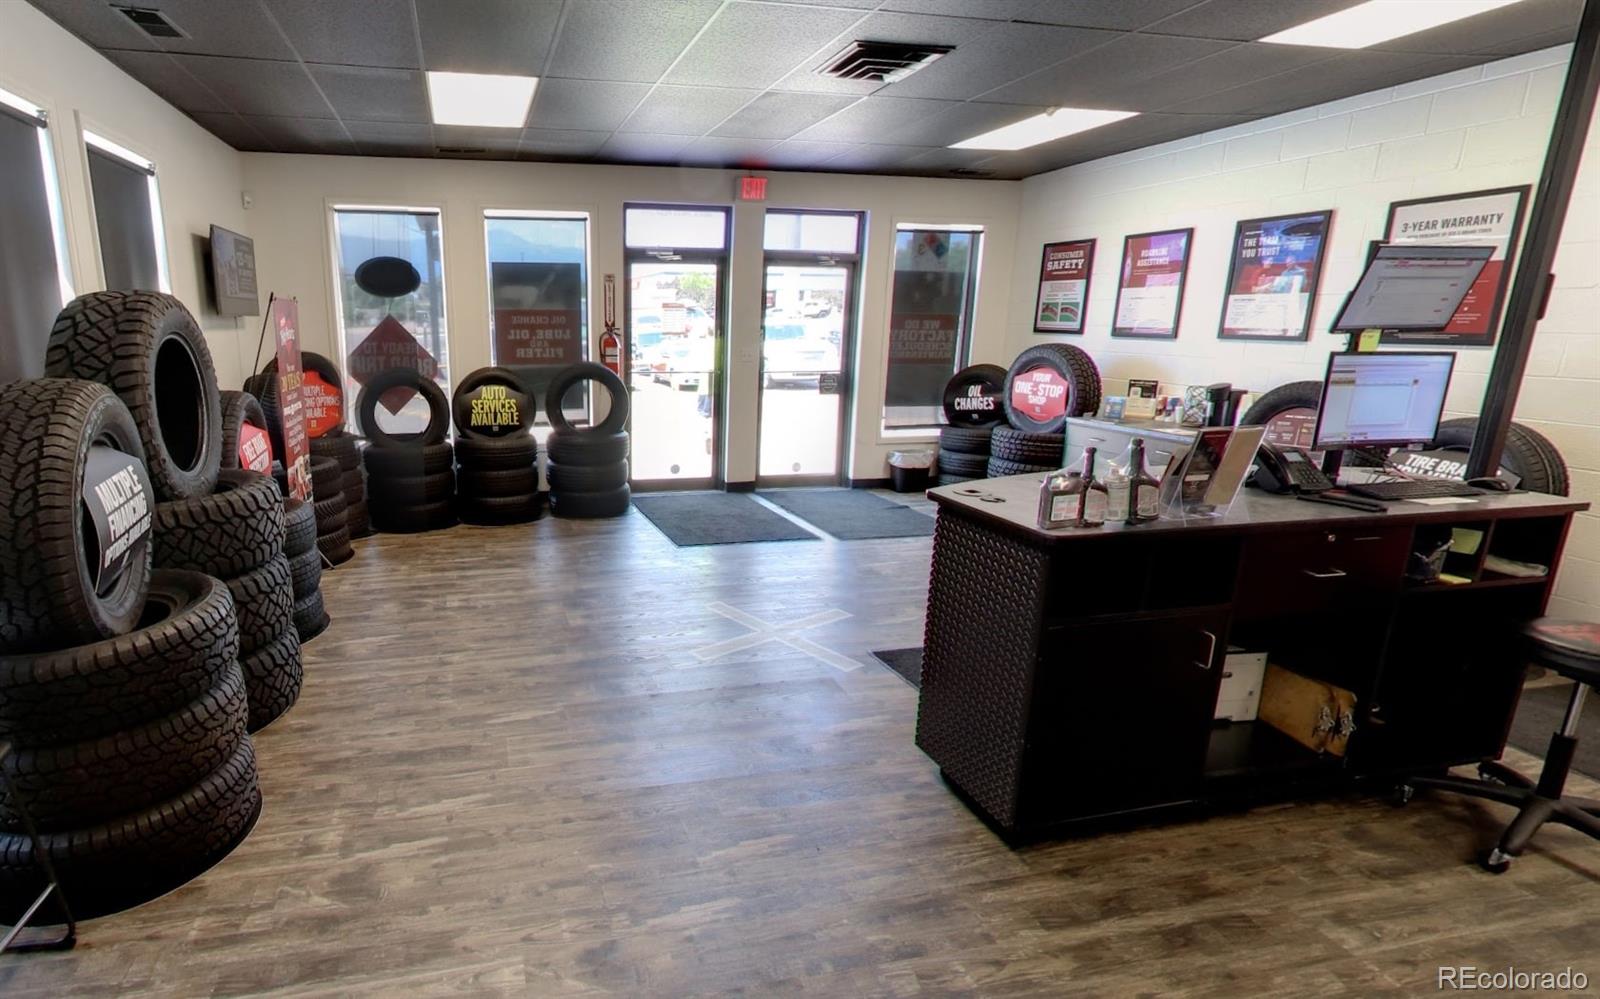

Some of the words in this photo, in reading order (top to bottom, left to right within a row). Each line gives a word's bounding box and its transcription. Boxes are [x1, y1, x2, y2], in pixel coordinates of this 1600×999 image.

[742, 178, 767, 199] EXIT
[1401, 219, 1438, 232] 3-YEAR
[1441, 213, 1504, 229] WARRANTY
[1243, 238, 1257, 248] THE
[1049, 250, 1084, 260] CONSUMER
[1242, 248, 1256, 258] YOU
[1257, 246, 1280, 257] TRUST
[1046, 258, 1085, 271] SAFETY
[303, 384, 326, 397] ULTIPLE
[481, 385, 506, 400] AUTO
[968, 385, 982, 397] OIL
[1015, 380, 1064, 398] ONE-STOP
[471, 399, 517, 413] SERVICES
[954, 396, 994, 410] CHANGES
[470, 412, 520, 426] AVAILABLE
[1405, 453, 1440, 470] TIRE
[1435, 460, 1467, 477] BRA
[94, 464, 143, 515] MULTIPLE
[107, 491, 148, 542] FINANCING
